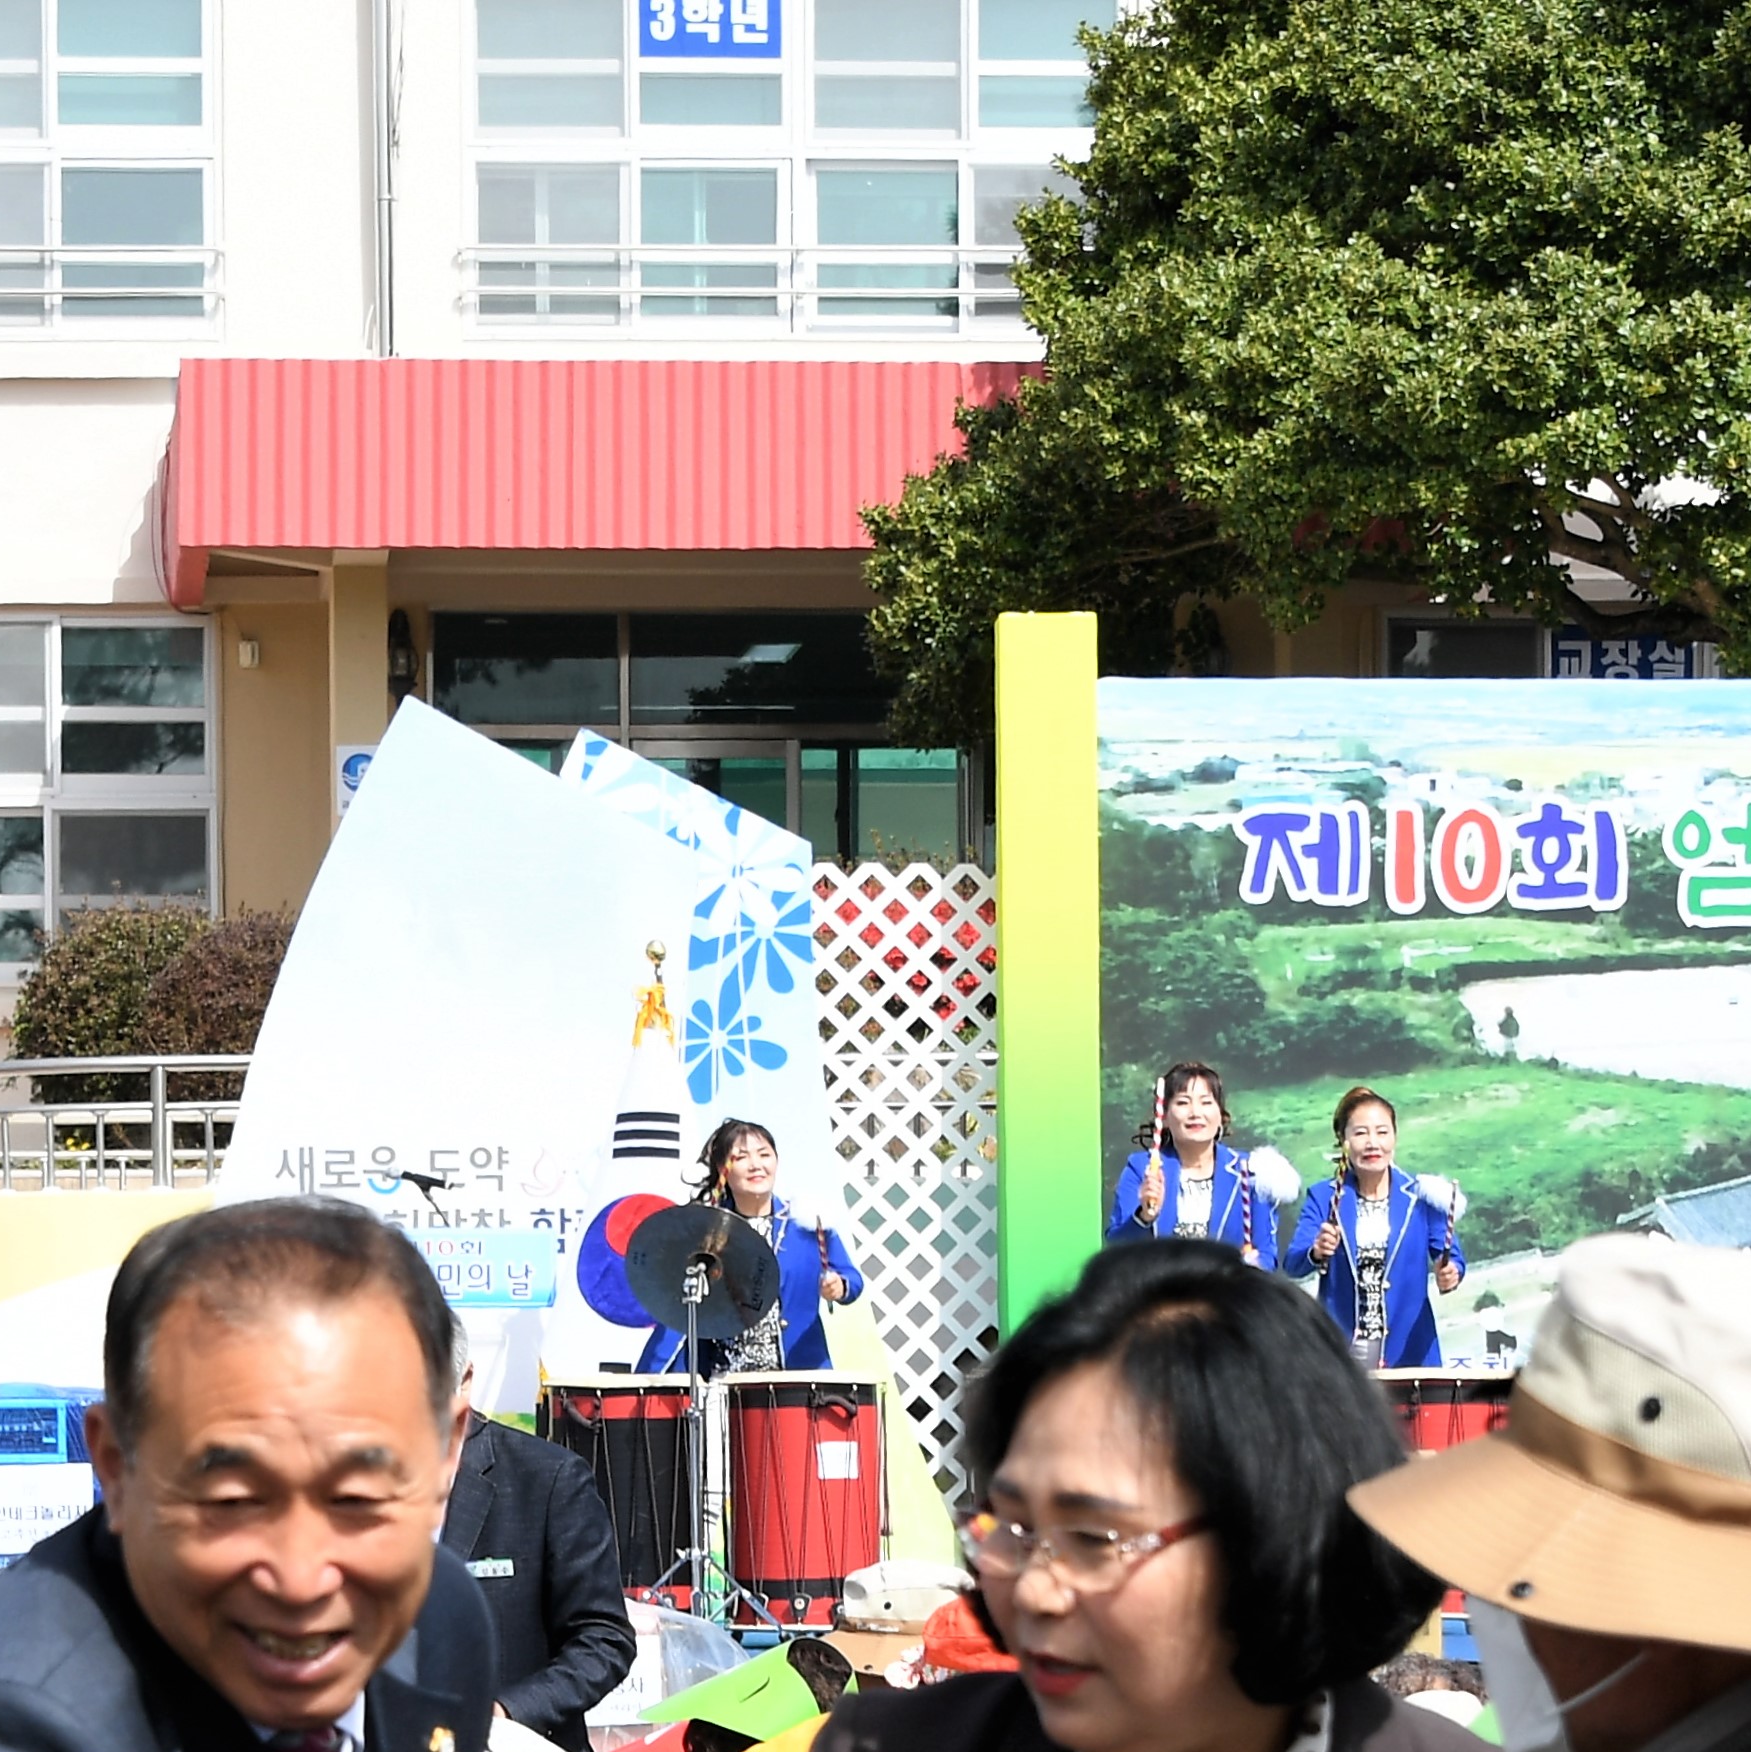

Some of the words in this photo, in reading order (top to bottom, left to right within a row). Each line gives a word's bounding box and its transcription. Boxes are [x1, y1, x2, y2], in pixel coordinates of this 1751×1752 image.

[649, 0, 769, 43] 3학년
[1557, 640, 1685, 679] 교장실
[1241, 802, 1621, 904] 제10회
[276, 1146, 400, 1195] 새로운
[429, 1146, 510, 1191] 도약
[414, 1240, 483, 1256] 10회
[507, 1263, 534, 1297] 날
